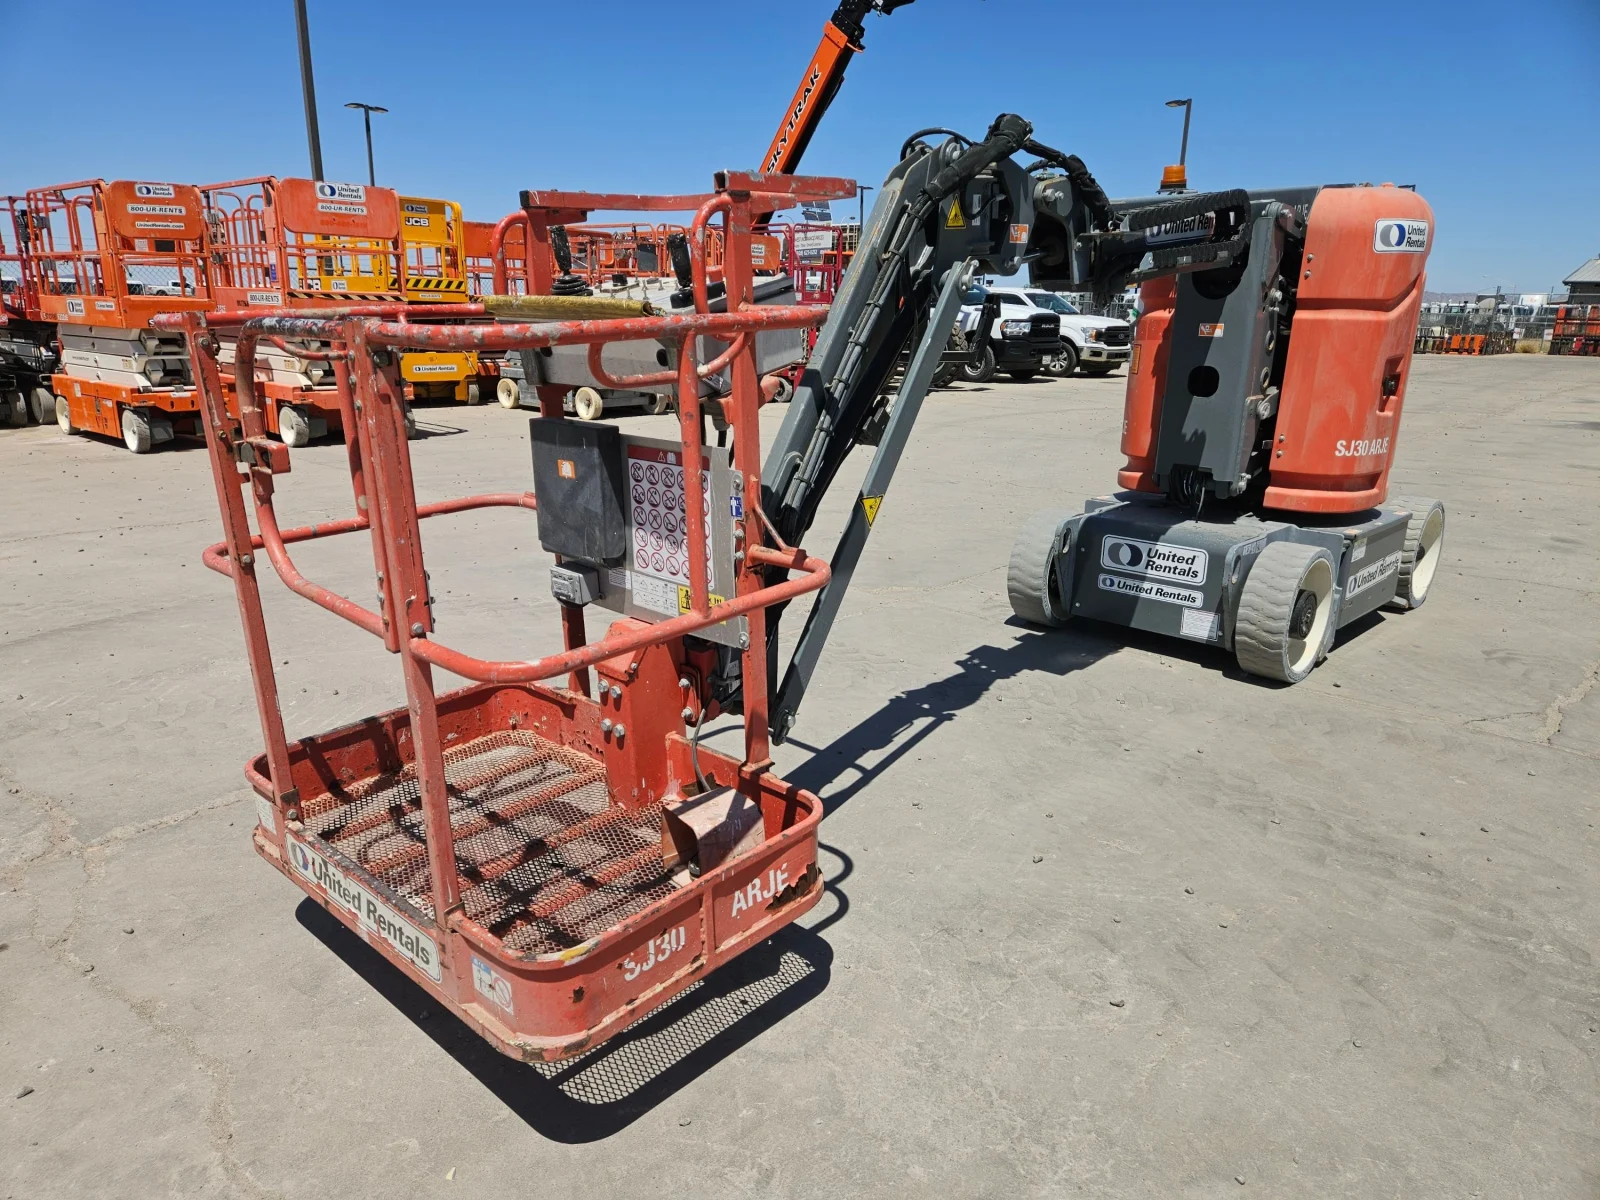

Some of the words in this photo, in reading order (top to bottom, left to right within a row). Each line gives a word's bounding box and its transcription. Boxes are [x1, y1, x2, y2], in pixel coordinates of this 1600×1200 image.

[766, 63, 821, 174] SKYTRAK
[337, 185, 359, 193] United
[337, 191, 362, 199] Rentals
[130, 206, 183, 214] 800-UR-RENTS
[320, 204, 365, 213] 800-UR-RENTS
[405, 217, 429, 227] JCB
[1163, 217, 1195, 234] United
[1407, 224, 1426, 236] United
[1405, 236, 1425, 248] Rentals
[249, 294, 279, 302] 800-UR-RENTS
[1334, 439, 1369, 456] SJ30
[1368, 437, 1389, 455] ARJE
[1146, 547, 1197, 566] United
[1144, 560, 1199, 579] Rentals
[1357, 566, 1378, 589] United
[1116, 580, 1153, 595] United
[1155, 587, 1197, 604] Rentals
[731, 863, 790, 918] ARJE
[311, 857, 361, 913] United
[366, 897, 430, 966] Rentals
[624, 926, 685, 982] SJ30
